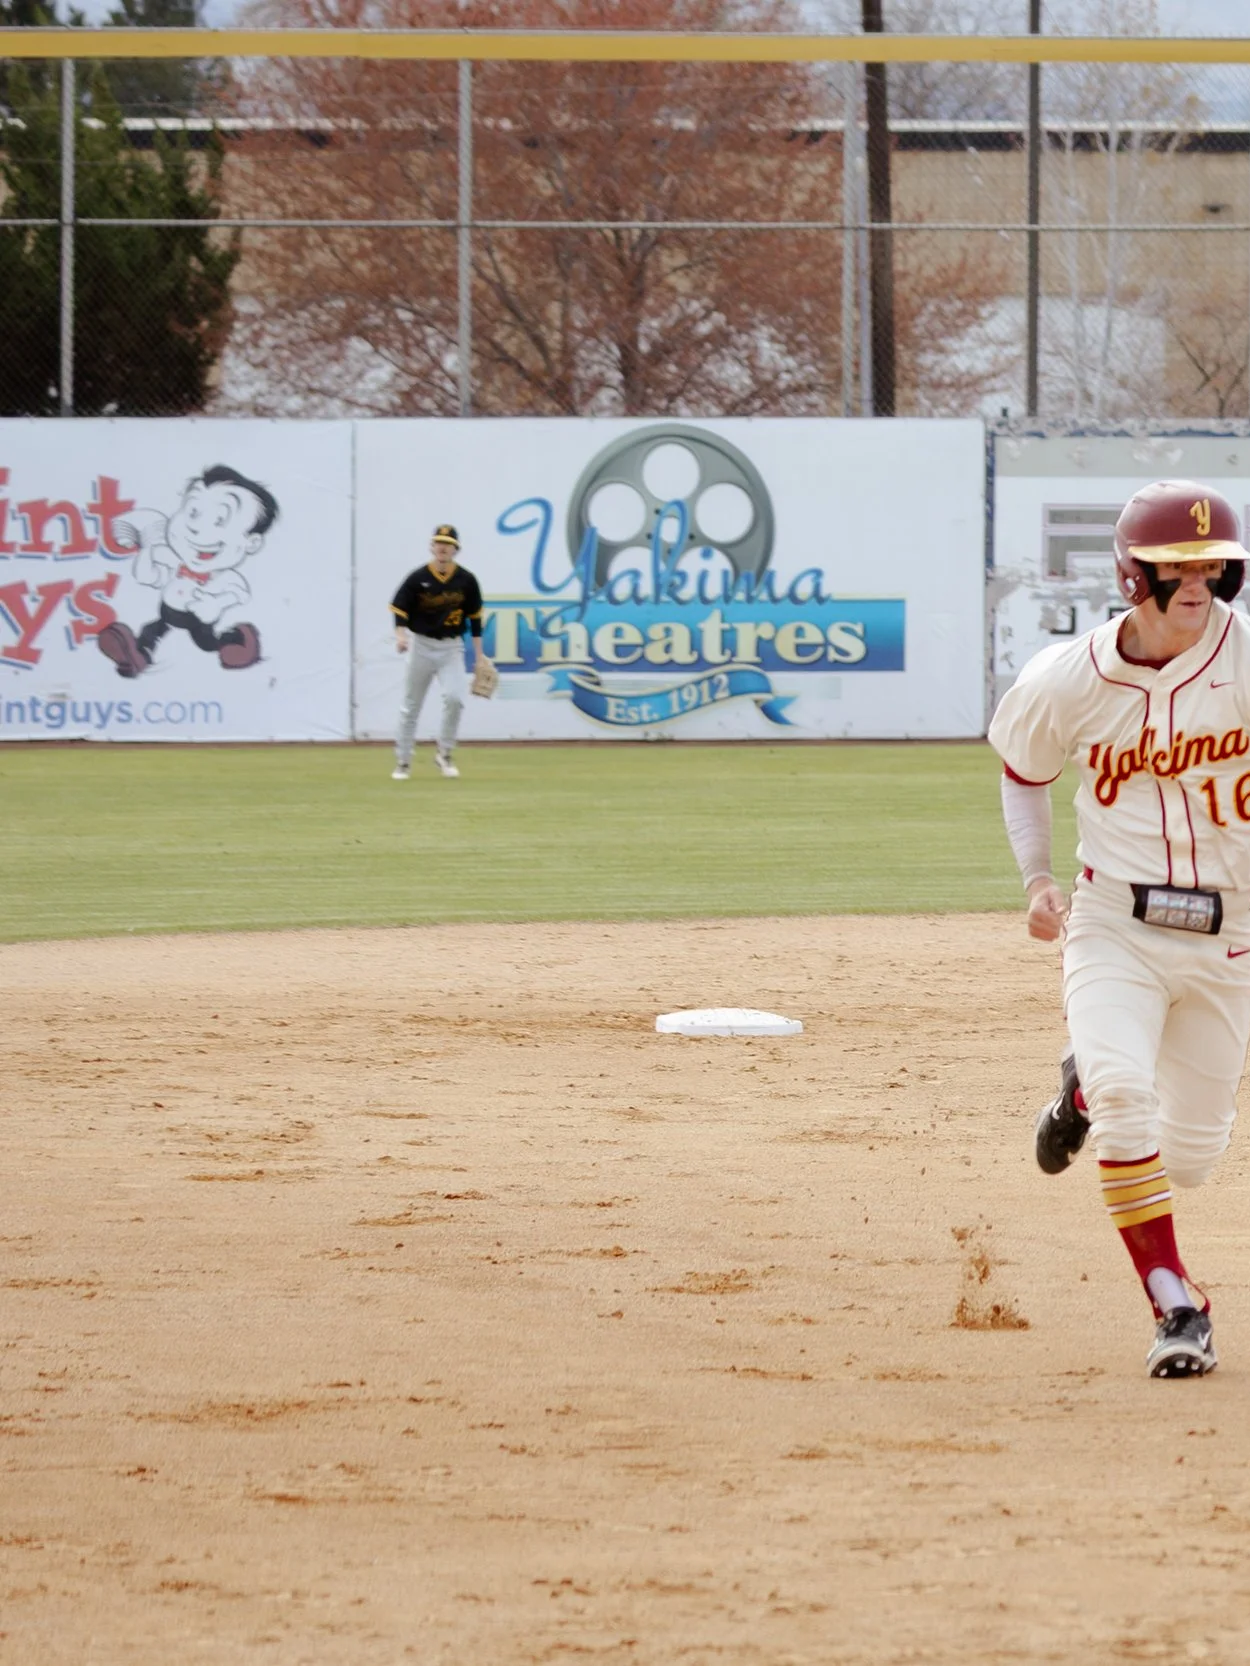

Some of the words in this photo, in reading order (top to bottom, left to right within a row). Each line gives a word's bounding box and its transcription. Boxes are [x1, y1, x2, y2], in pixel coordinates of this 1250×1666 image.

[495, 497, 831, 640] Yakima
[483, 606, 868, 667] Theatres
[0, 695, 224, 729] ntguys.com
[606, 698, 659, 724] Est.
[669, 675, 730, 714] 1912
[1088, 725, 1250, 808] Yakima
